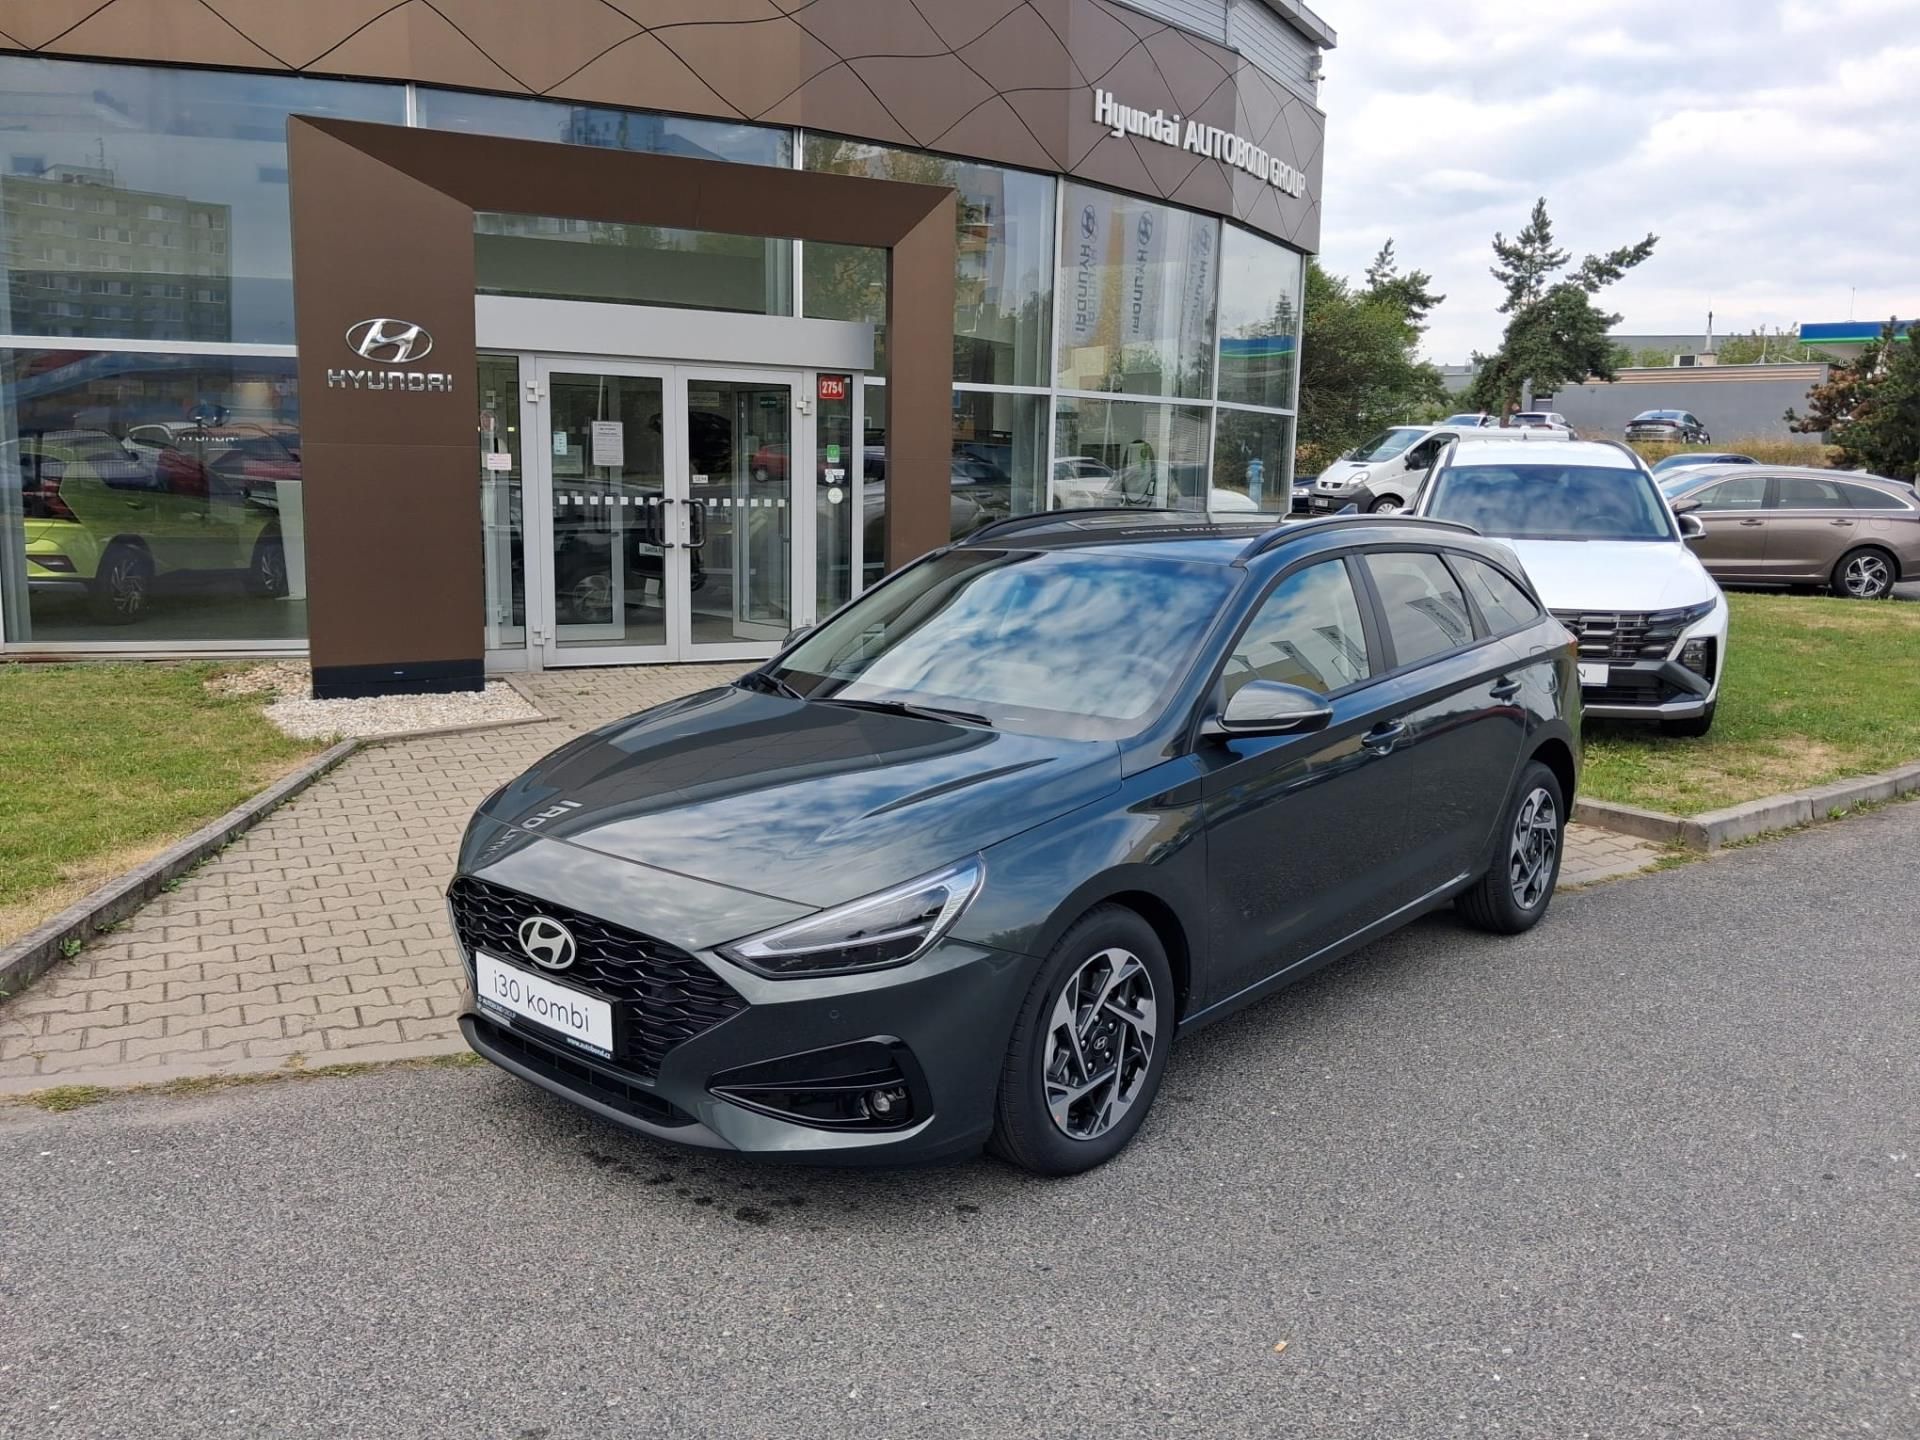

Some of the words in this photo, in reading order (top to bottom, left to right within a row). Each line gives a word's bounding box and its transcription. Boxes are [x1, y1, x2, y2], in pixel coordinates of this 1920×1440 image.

[1094, 88, 1180, 147] Hyundai
[1269, 157, 1305, 199] GROUP
[1075, 244, 1090, 332] HYUNDAI
[327, 368, 453, 392] HYUNDAI
[821, 381, 843, 394] 2754
[493, 970, 521, 1004] i30
[526, 985, 589, 1033] kombi
